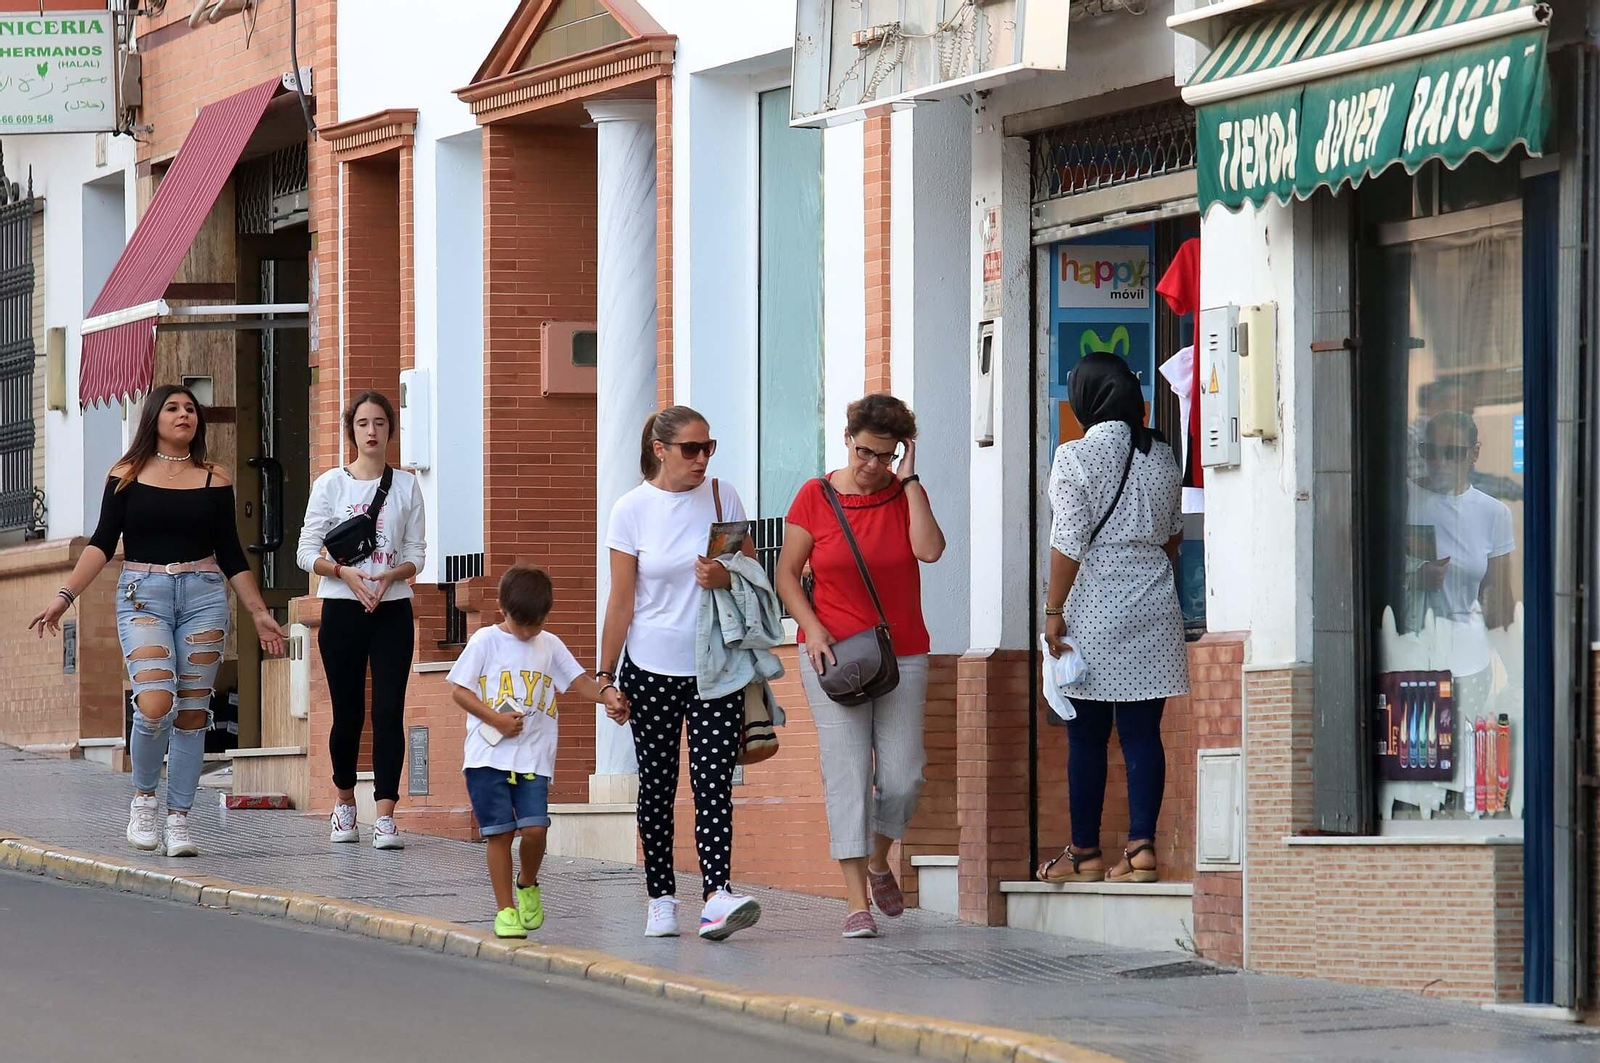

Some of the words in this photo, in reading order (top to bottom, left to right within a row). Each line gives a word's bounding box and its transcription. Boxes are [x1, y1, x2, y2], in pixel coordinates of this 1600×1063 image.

[0, 46, 103, 57] HERMANOS
[58, 61, 100, 69] (HALAL)
[0, 115, 13, 124] 66
[16, 115, 34, 123] 609
[36, 115, 54, 123] 548
[1219, 108, 1298, 192] TIENDA
[1315, 83, 1395, 174] JOVEN
[1061, 252, 1146, 290] happy
[1110, 289, 1144, 299] móvil
